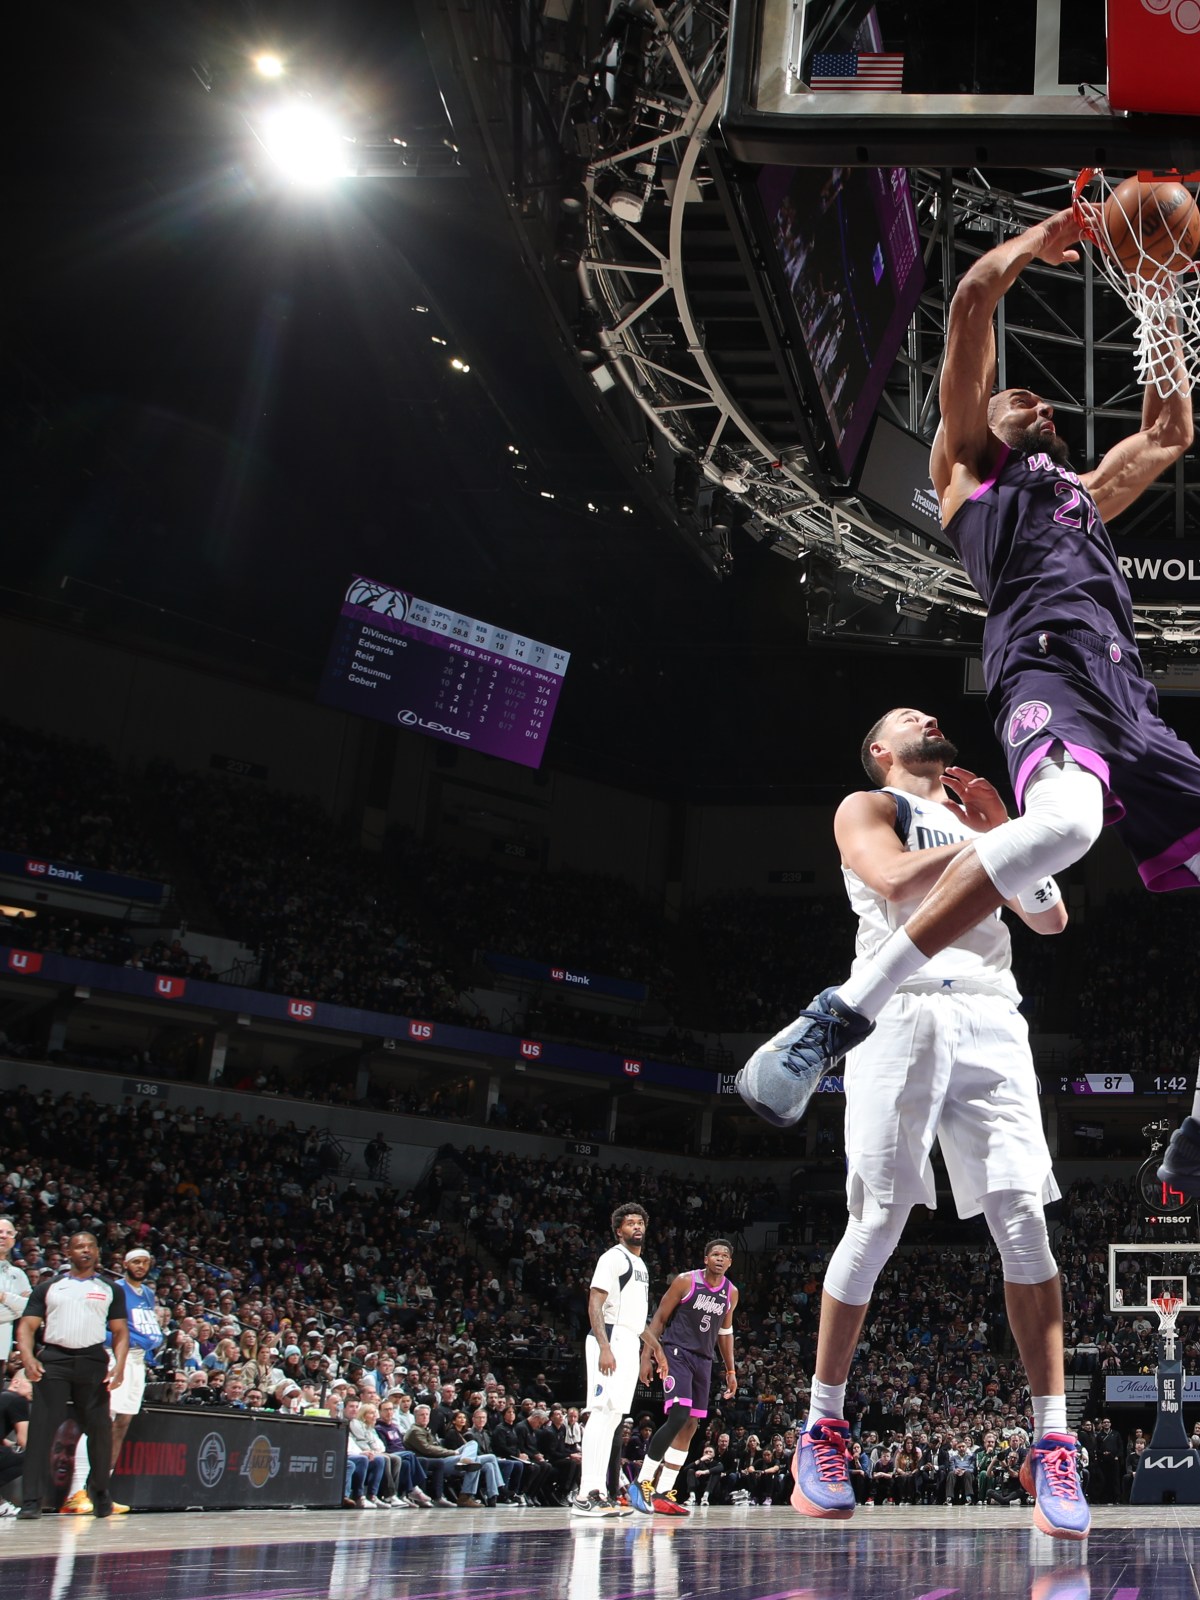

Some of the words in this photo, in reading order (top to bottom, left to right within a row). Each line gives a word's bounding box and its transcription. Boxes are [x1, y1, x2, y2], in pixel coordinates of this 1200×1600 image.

[410, 613, 427, 623] 45.8
[431, 620, 447, 630] 37.9
[452, 627, 469, 638] 58.8
[475, 635, 485, 643] 39
[495, 642, 504, 650] 19
[515, 649, 523, 657] 14
[476, 625, 487, 634] REB
[496, 633, 508, 641] AST
[517, 639, 526, 647] TO
[553, 653, 565, 661] BLK
[361, 626, 408, 647] DiVincenzo
[537, 686, 551, 696] 3/4
[449, 643, 461, 652] PTS
[463, 648, 475, 657] REB
[478, 653, 491, 662] AST
[358, 638, 394, 656] Edwards
[534, 697, 548, 707] 3/9
[354, 650, 375, 662] Reid
[533, 708, 544, 718] 1/3
[351, 661, 391, 680] Dosunmu
[530, 719, 541, 728] 1/4
[348, 673, 377, 688] Gobert
[525, 730, 538, 739] 0/0
[418, 718, 471, 740] LEXUS
[28, 862, 46, 873] us
[47, 864, 85, 882] bank
[552, 970, 564, 979] us
[565, 972, 590, 985] bank
[290, 1002, 313, 1017] us
[411, 1023, 432, 1038] us
[521, 1041, 541, 1058] us
[625, 1062, 640, 1073] us
[135, 1083, 158, 1096] 136
[1061, 1084, 1067, 1092] 4
[1079, 1084, 1085, 1092] 5
[1104, 1077, 1122, 1090] 87
[1153, 1077, 1187, 1090] 1:42
[575, 1144, 591, 1155] 138
[1157, 1216, 1192, 1224] TISSOT
[692, 1293, 726, 1316] Wolves
[699, 1314, 711, 1333] 5
[1163, 1379, 1175, 1390] GET
[1164, 1390, 1176, 1400] THE
[1166, 1401, 1179, 1413] App
[289, 1455, 318, 1472] ESPN
